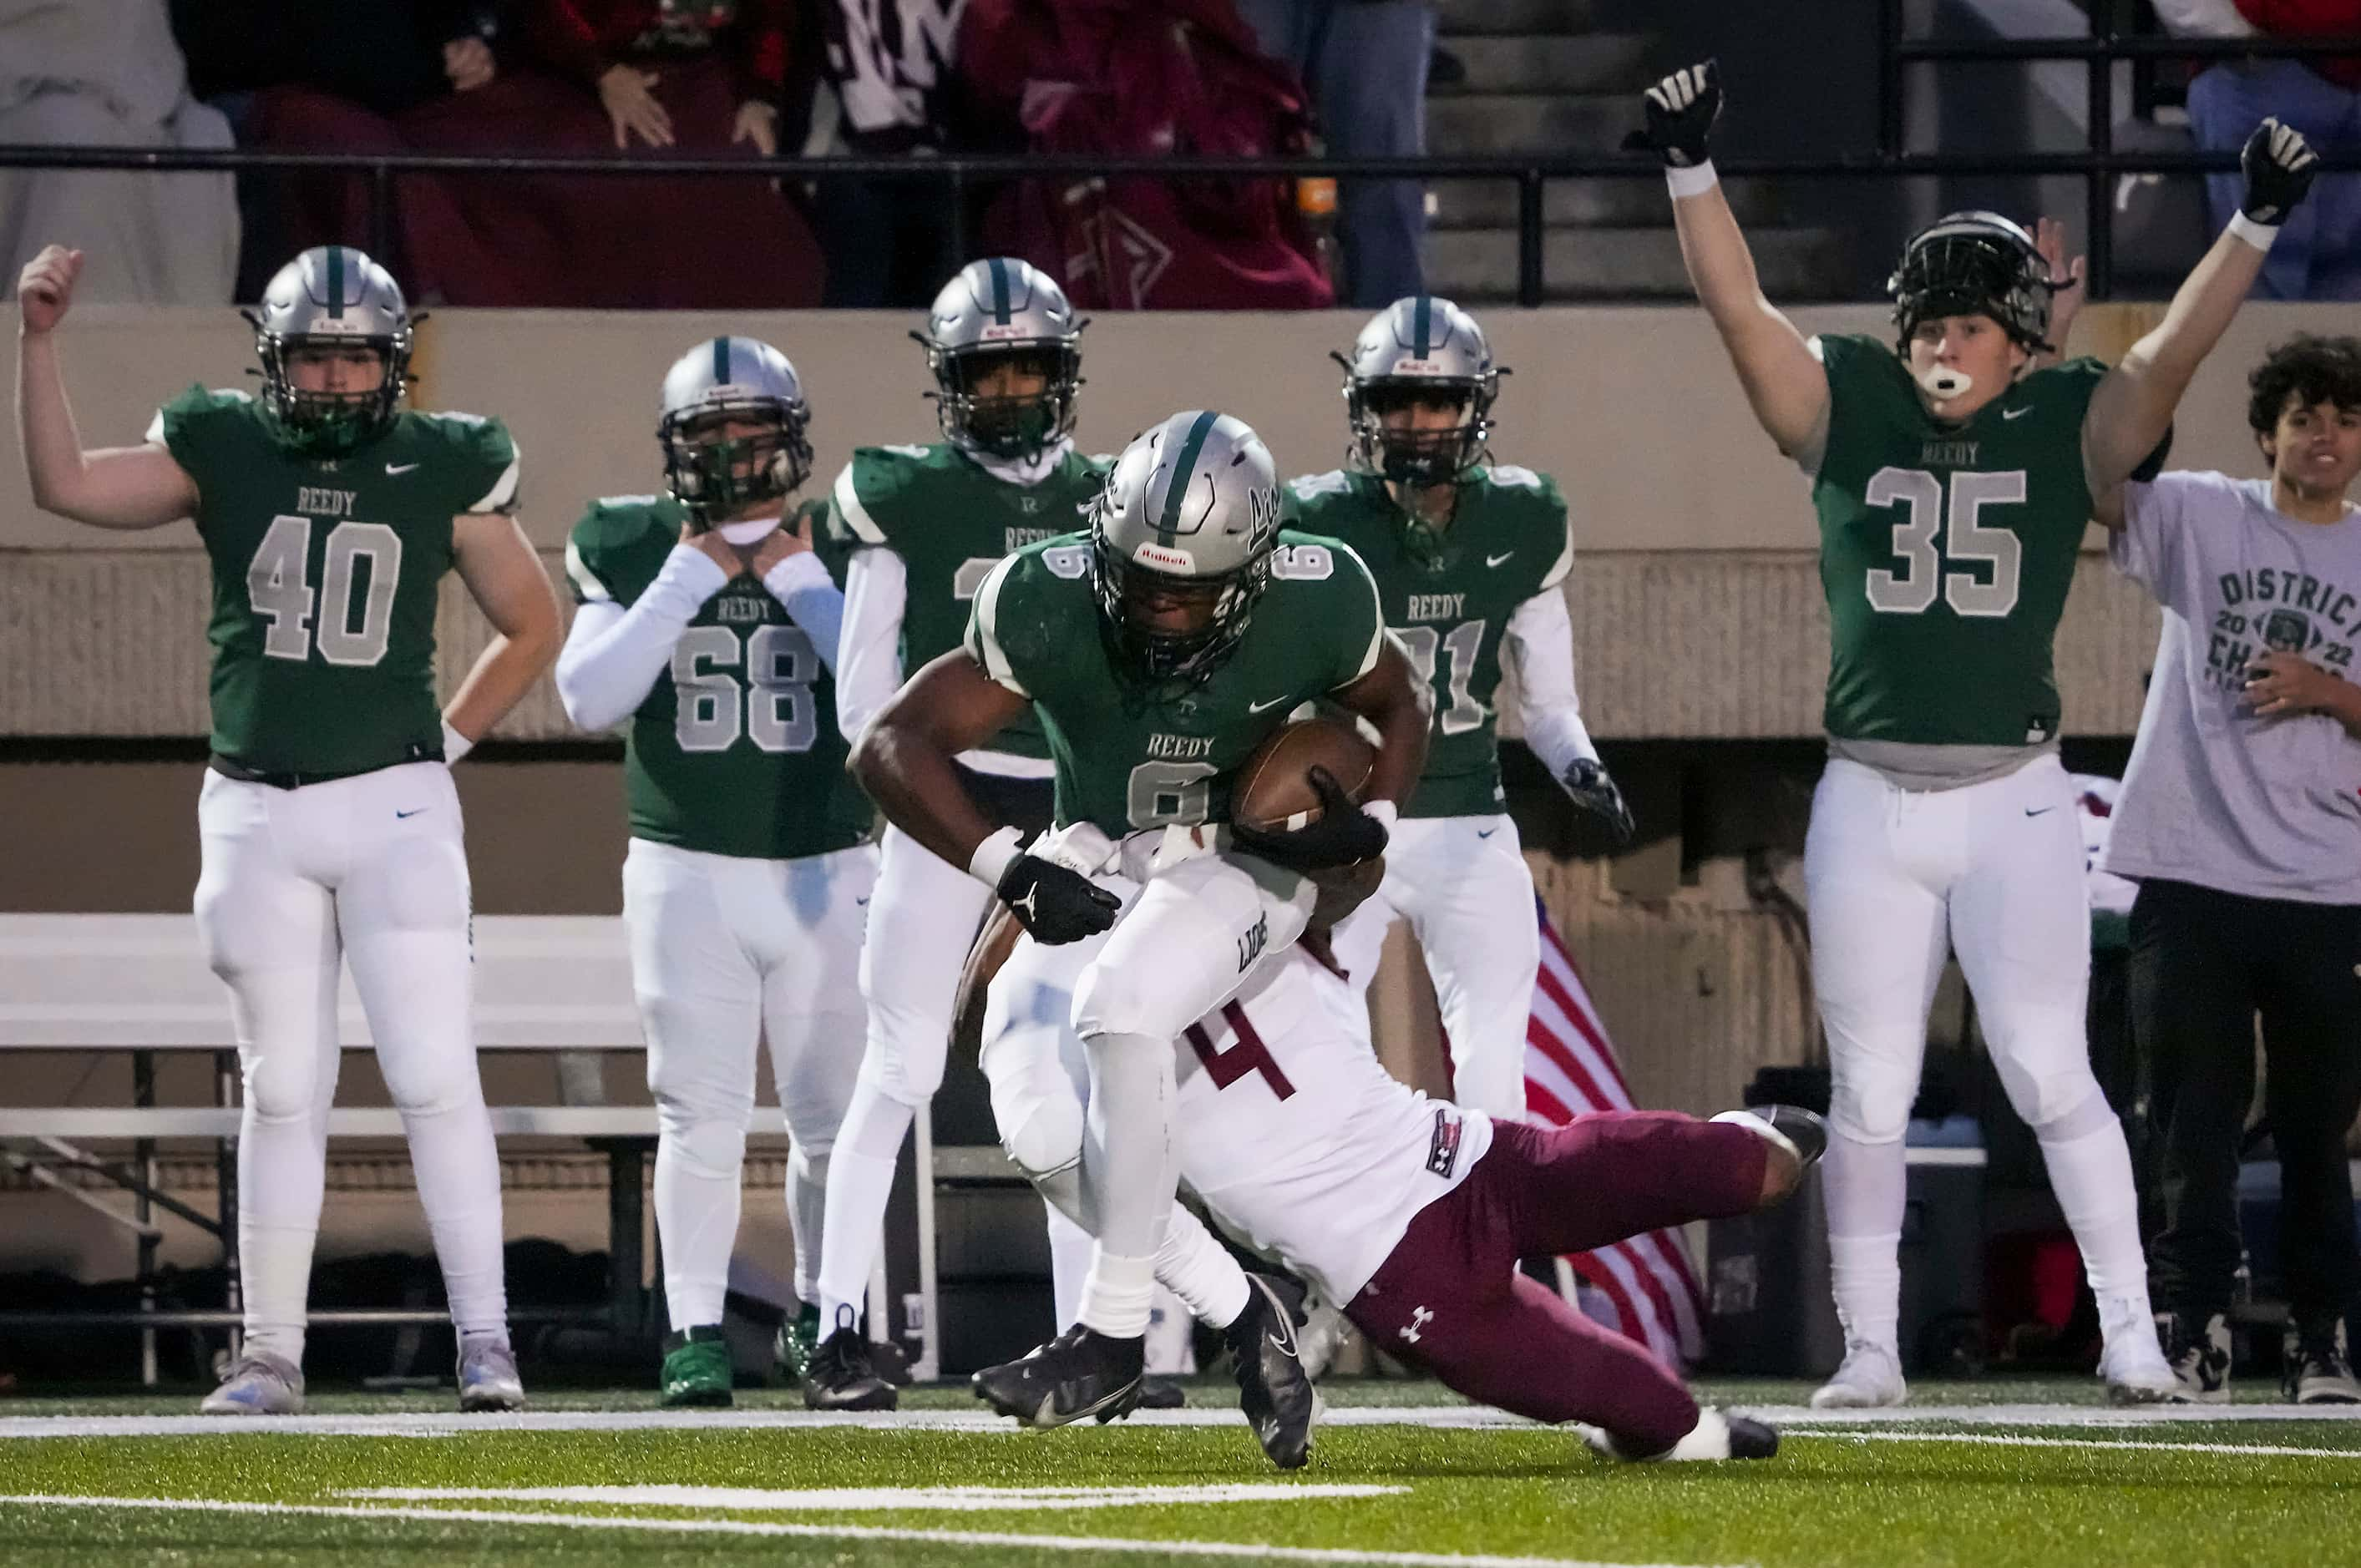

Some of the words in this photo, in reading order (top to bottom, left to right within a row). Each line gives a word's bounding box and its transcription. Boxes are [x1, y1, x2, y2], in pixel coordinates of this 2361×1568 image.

[297, 486, 357, 516] REEDY
[1866, 465, 2027, 617] 35
[246, 514, 403, 665] 40
[717, 596, 771, 622] REEDY
[1407, 593, 1466, 620] REEDY
[671, 625, 819, 751] 68
[1147, 733, 1217, 757] REEDY
[1127, 760, 1218, 827] 6
[1183, 998, 1297, 1102] 4
